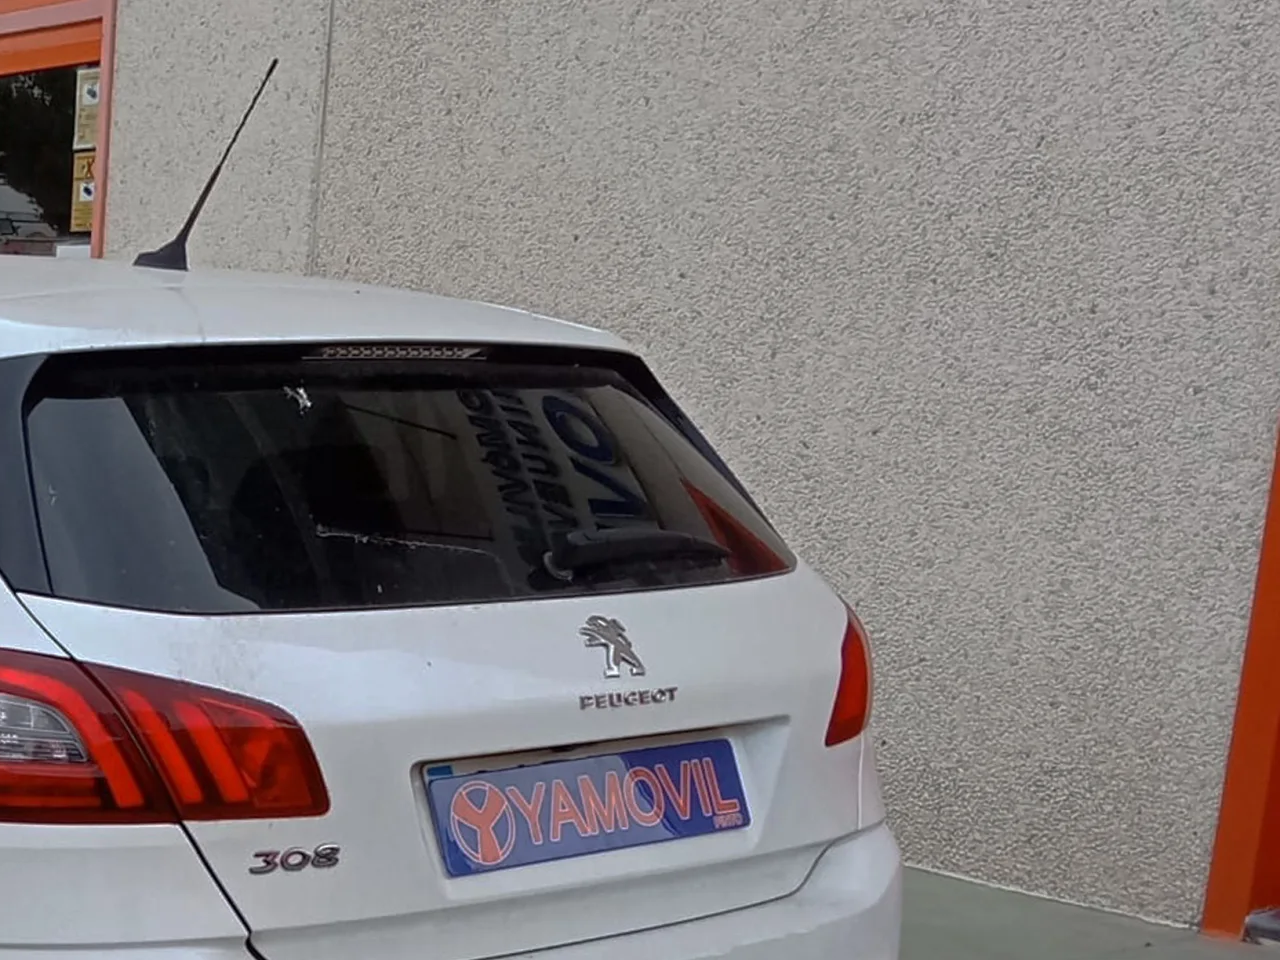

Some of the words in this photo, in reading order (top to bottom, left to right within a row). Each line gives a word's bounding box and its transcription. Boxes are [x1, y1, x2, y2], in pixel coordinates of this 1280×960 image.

[579, 686, 679, 710] PEUGEOT
[506, 757, 741, 845] YAMOVIL
[248, 842, 341, 875] 308
